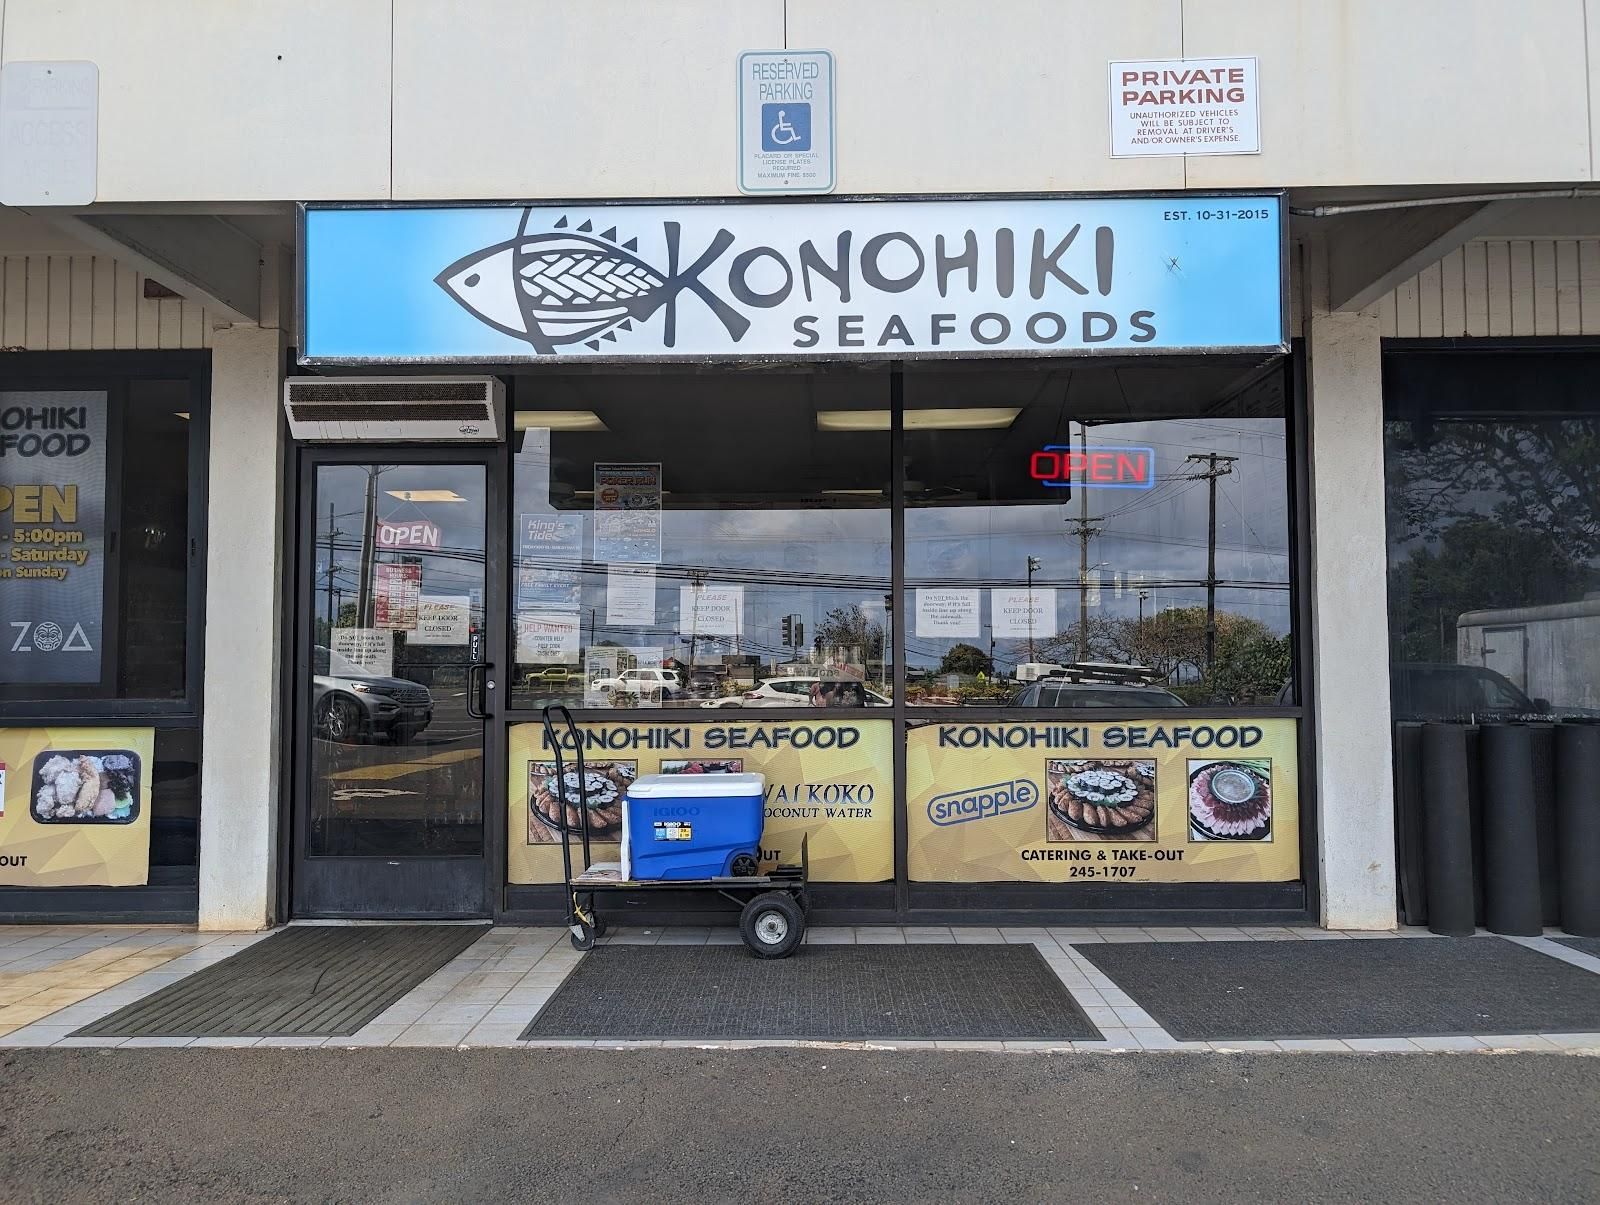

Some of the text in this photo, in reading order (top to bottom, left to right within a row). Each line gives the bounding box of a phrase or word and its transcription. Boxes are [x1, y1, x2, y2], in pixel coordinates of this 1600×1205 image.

[752, 61, 819, 80] RESERVED
[1122, 68, 1244, 86] PRIVATE
[759, 82, 813, 100] PARKING
[1122, 88, 1245, 106] PARKING
[1130, 109, 1239, 119] UNAUTHORIZED VEHICLES
[1178, 118, 1214, 126] SUBJECT
[1131, 135, 1240, 145] AND/OR OWNER'S EXPENSE.
[1137, 126, 1233, 136] REMOVAL AT DRIVER'S
[1164, 209, 1269, 220] EST. 10-31-2015
[663, 220, 1114, 348] KONOHIKI
[793, 310, 1156, 347] SEAFOODS
[1030, 452, 1146, 481] OPEN
[528, 520, 565, 531] King's
[14, 528, 83, 547] 5:00pm
[380, 525, 438, 546] OPEN
[11, 546, 89, 566] Saturday
[16, 566, 67, 580] Sunday
[524, 623, 572, 632] HELP WANTED
[542, 726, 860, 749] KONOHIKI SEAFOOD
[938, 725, 1263, 748] KONOHIKI SEAFOOD
[804, 783, 874, 805] KOKO
[936, 780, 1030, 819] snapple
[653, 806, 700, 817] IGLOO
[824, 807, 872, 818] WATER
[0, 856, 28, 867] OUT
[1021, 849, 1185, 861] CATERING & TAKE-OUT
[1069, 866, 1136, 877] 245-1707
